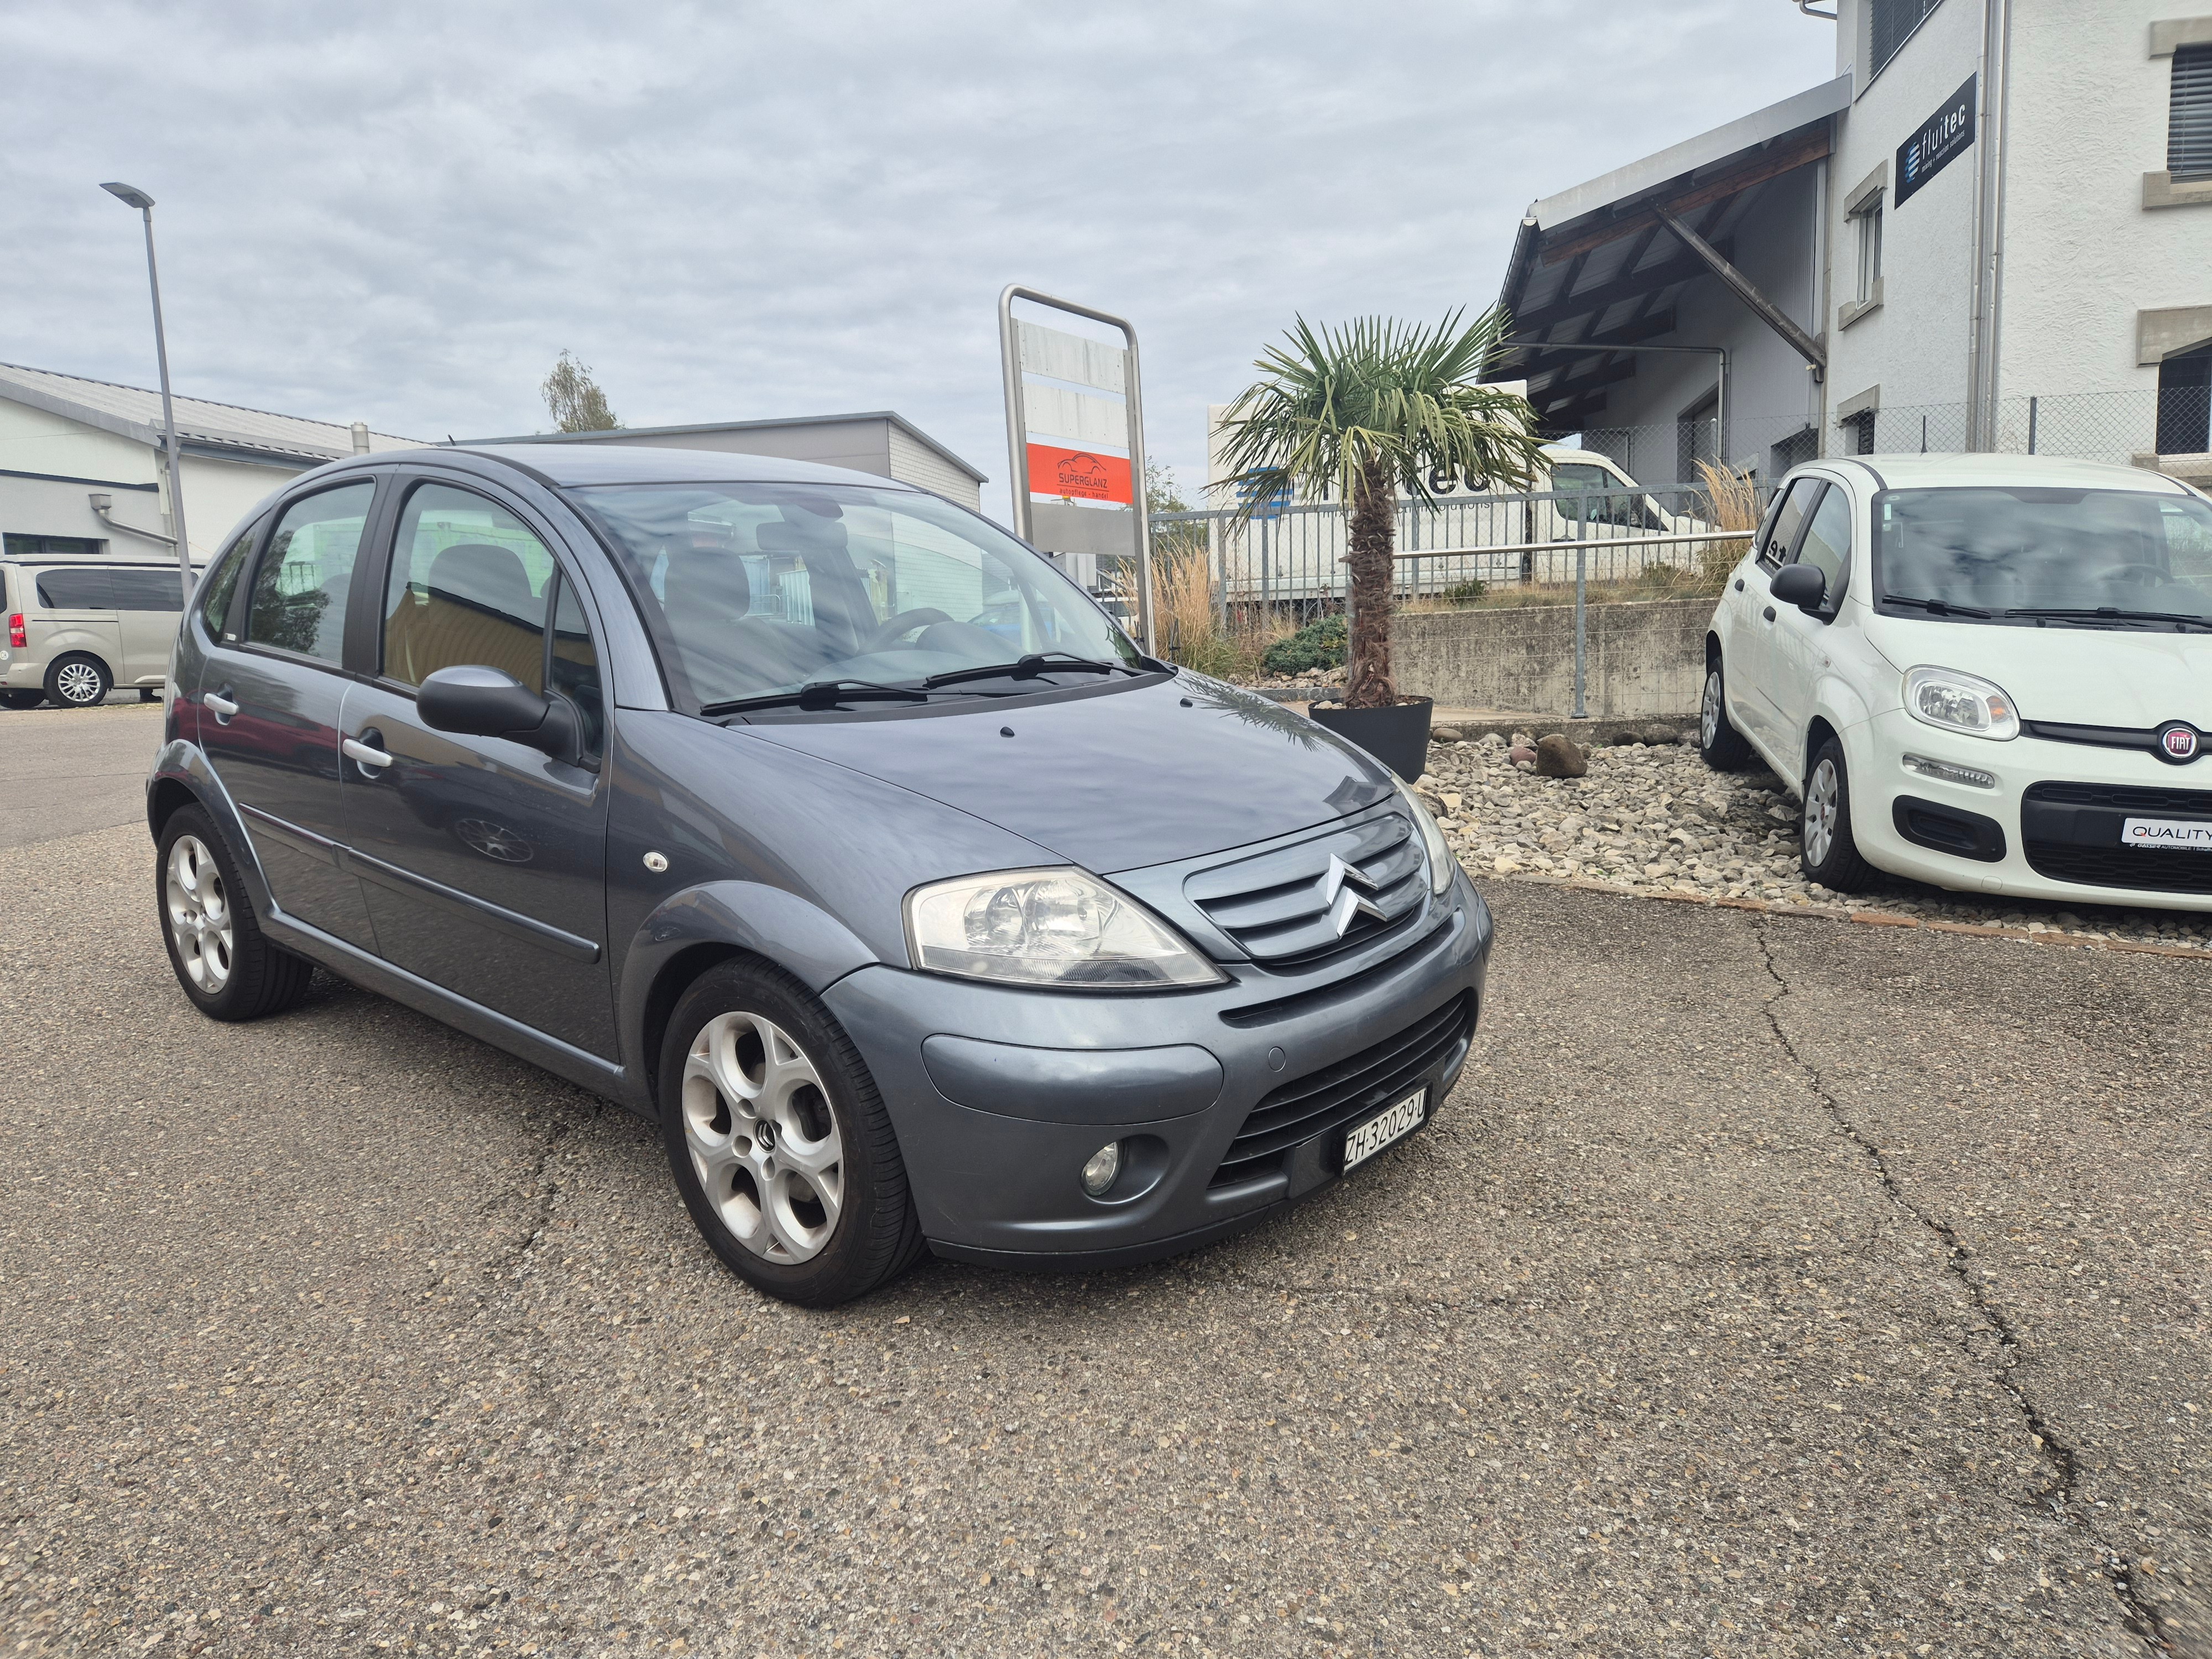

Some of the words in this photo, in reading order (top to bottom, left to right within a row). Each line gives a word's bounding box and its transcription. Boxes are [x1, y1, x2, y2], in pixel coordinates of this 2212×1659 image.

[1922, 104, 1965, 160] fluitec
[1949, 129, 1965, 148] solutions
[1058, 473, 1108, 488] SUPERGLANZ
[1059, 488, 1087, 497] autopflege
[1092, 491, 1109, 499] handel
[2171, 736, 2190, 750] FIAT
